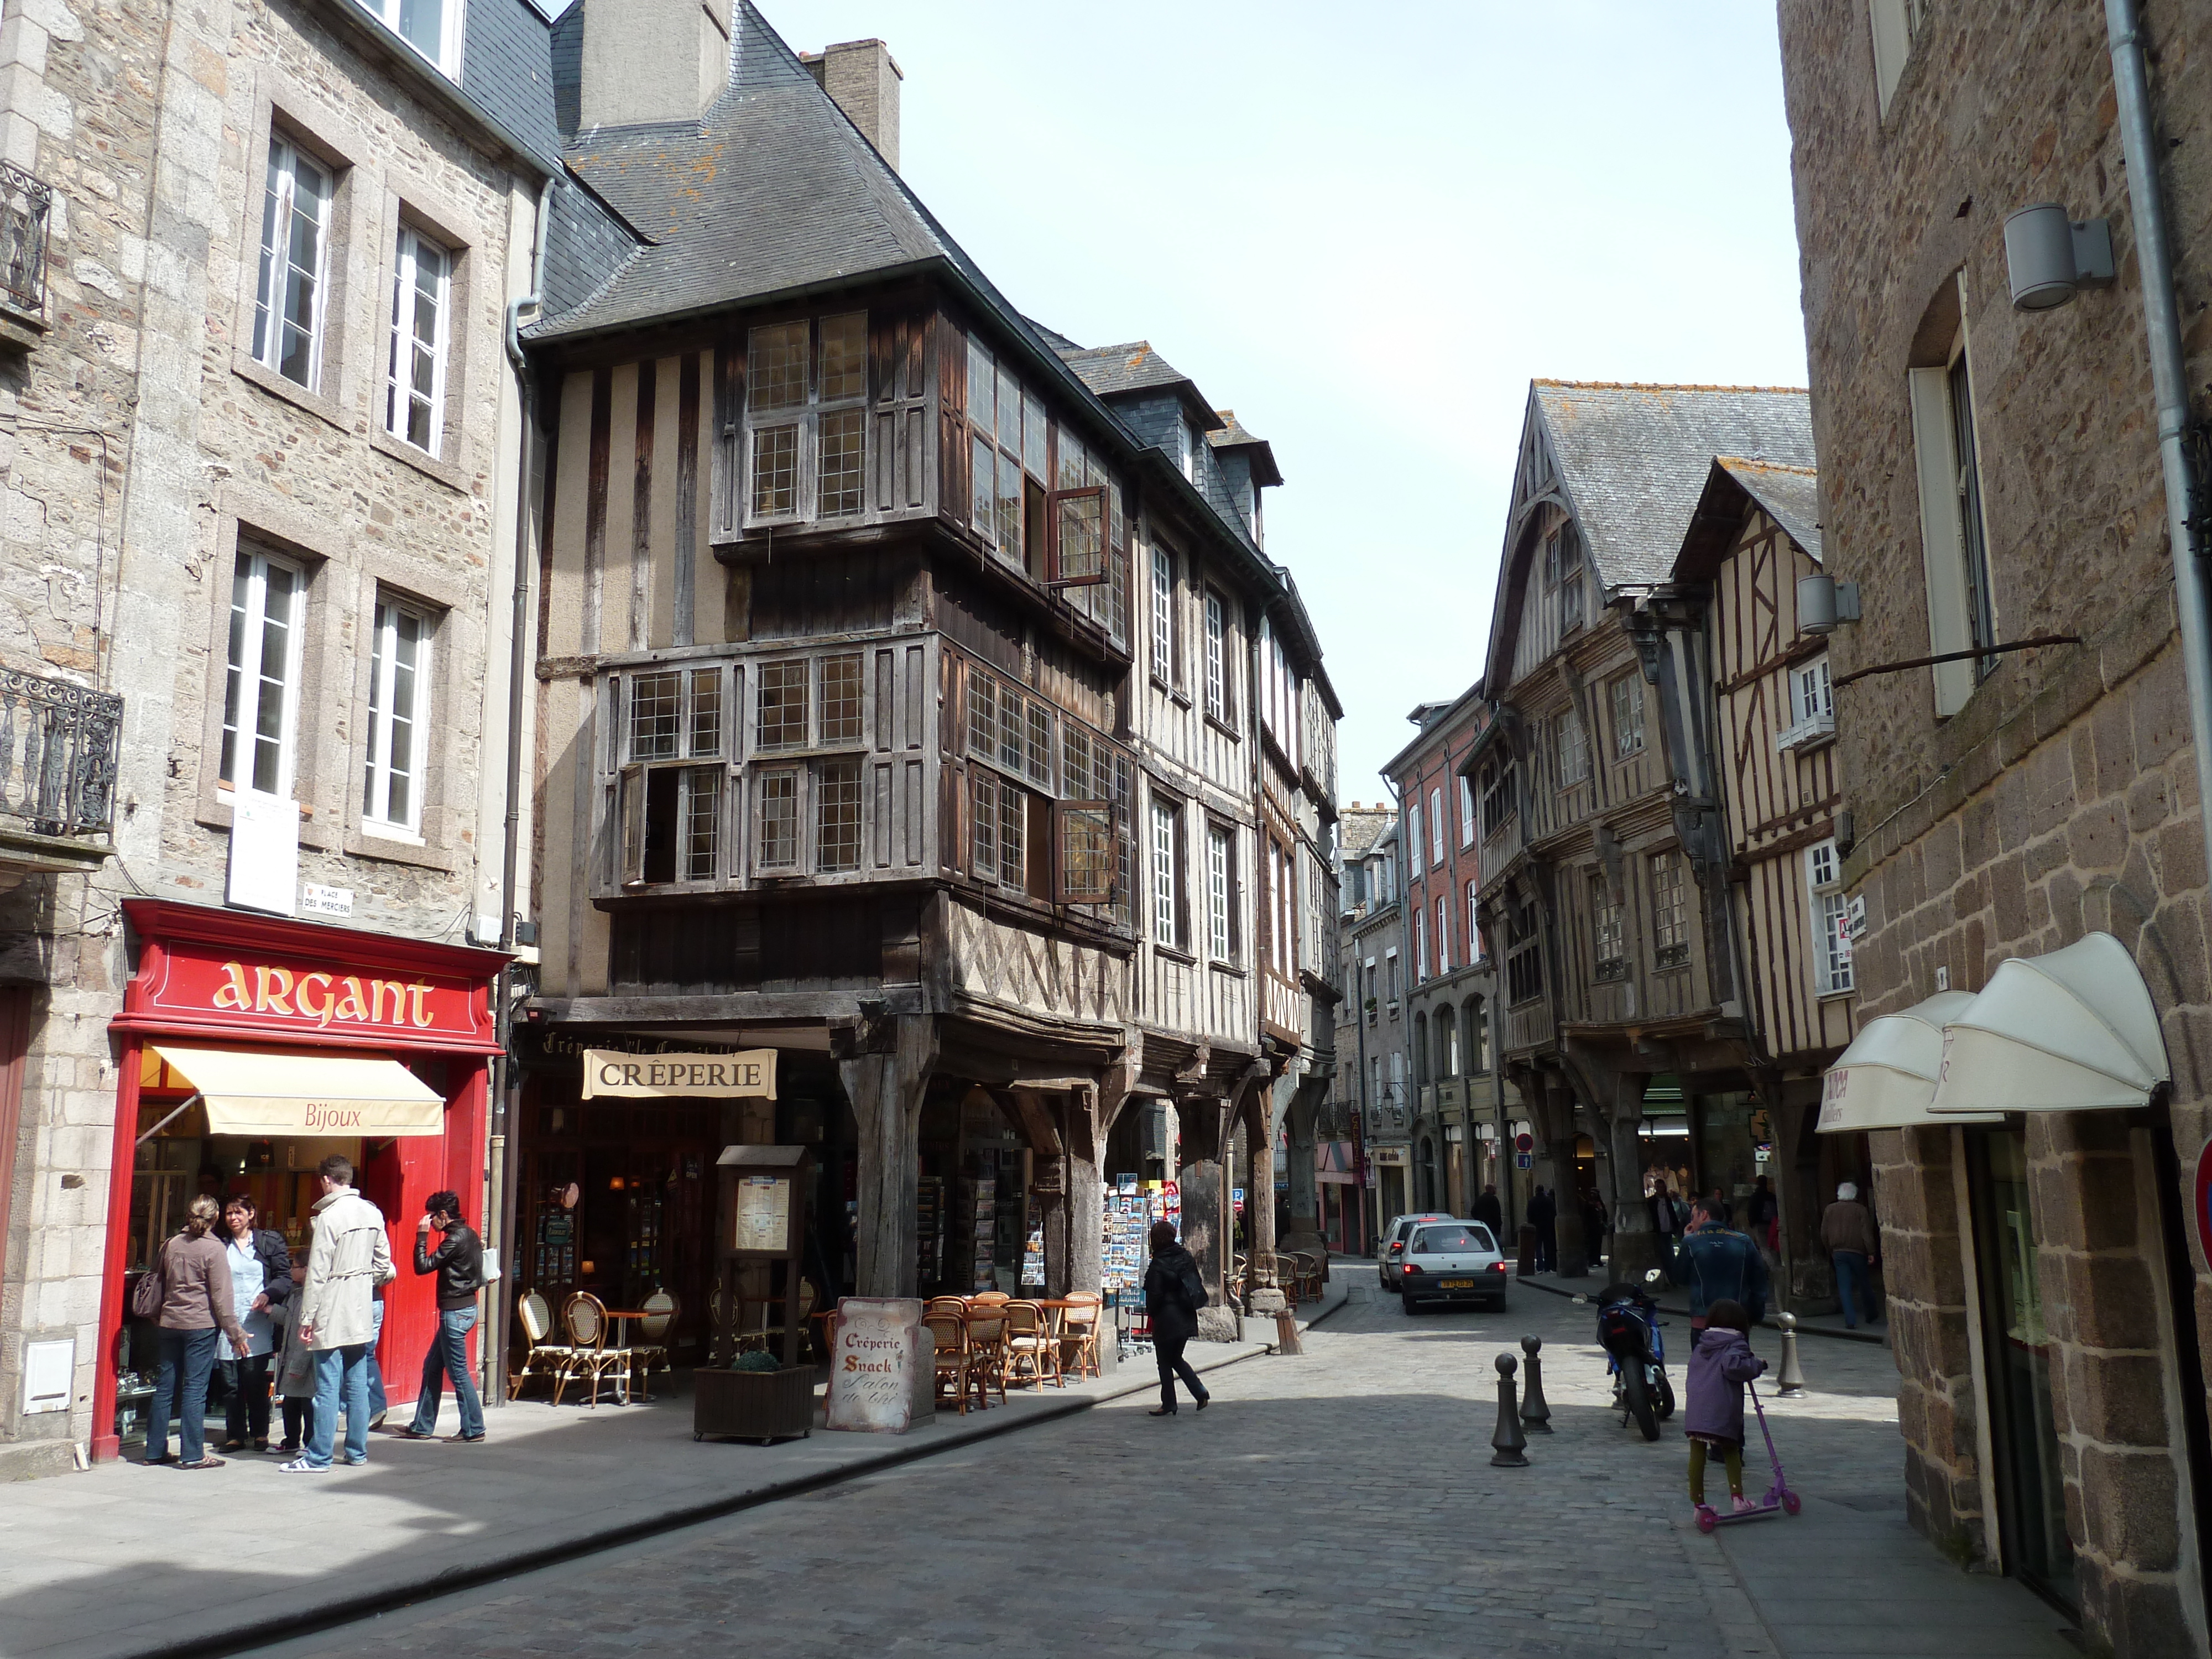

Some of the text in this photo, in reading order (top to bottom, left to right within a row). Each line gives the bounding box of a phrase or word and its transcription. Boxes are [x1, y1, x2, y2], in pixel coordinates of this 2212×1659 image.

[321, 889, 338, 899] PLACE
[305, 898, 350, 913] DES MERCIERS
[599, 1059, 761, 1087] CRÊPERIE
[305, 1103, 361, 1132] Bijoux
[846, 1333, 900, 1350] Crêperie
[842, 1355, 891, 1373] Snack
[843, 1374, 899, 1390] Salon
